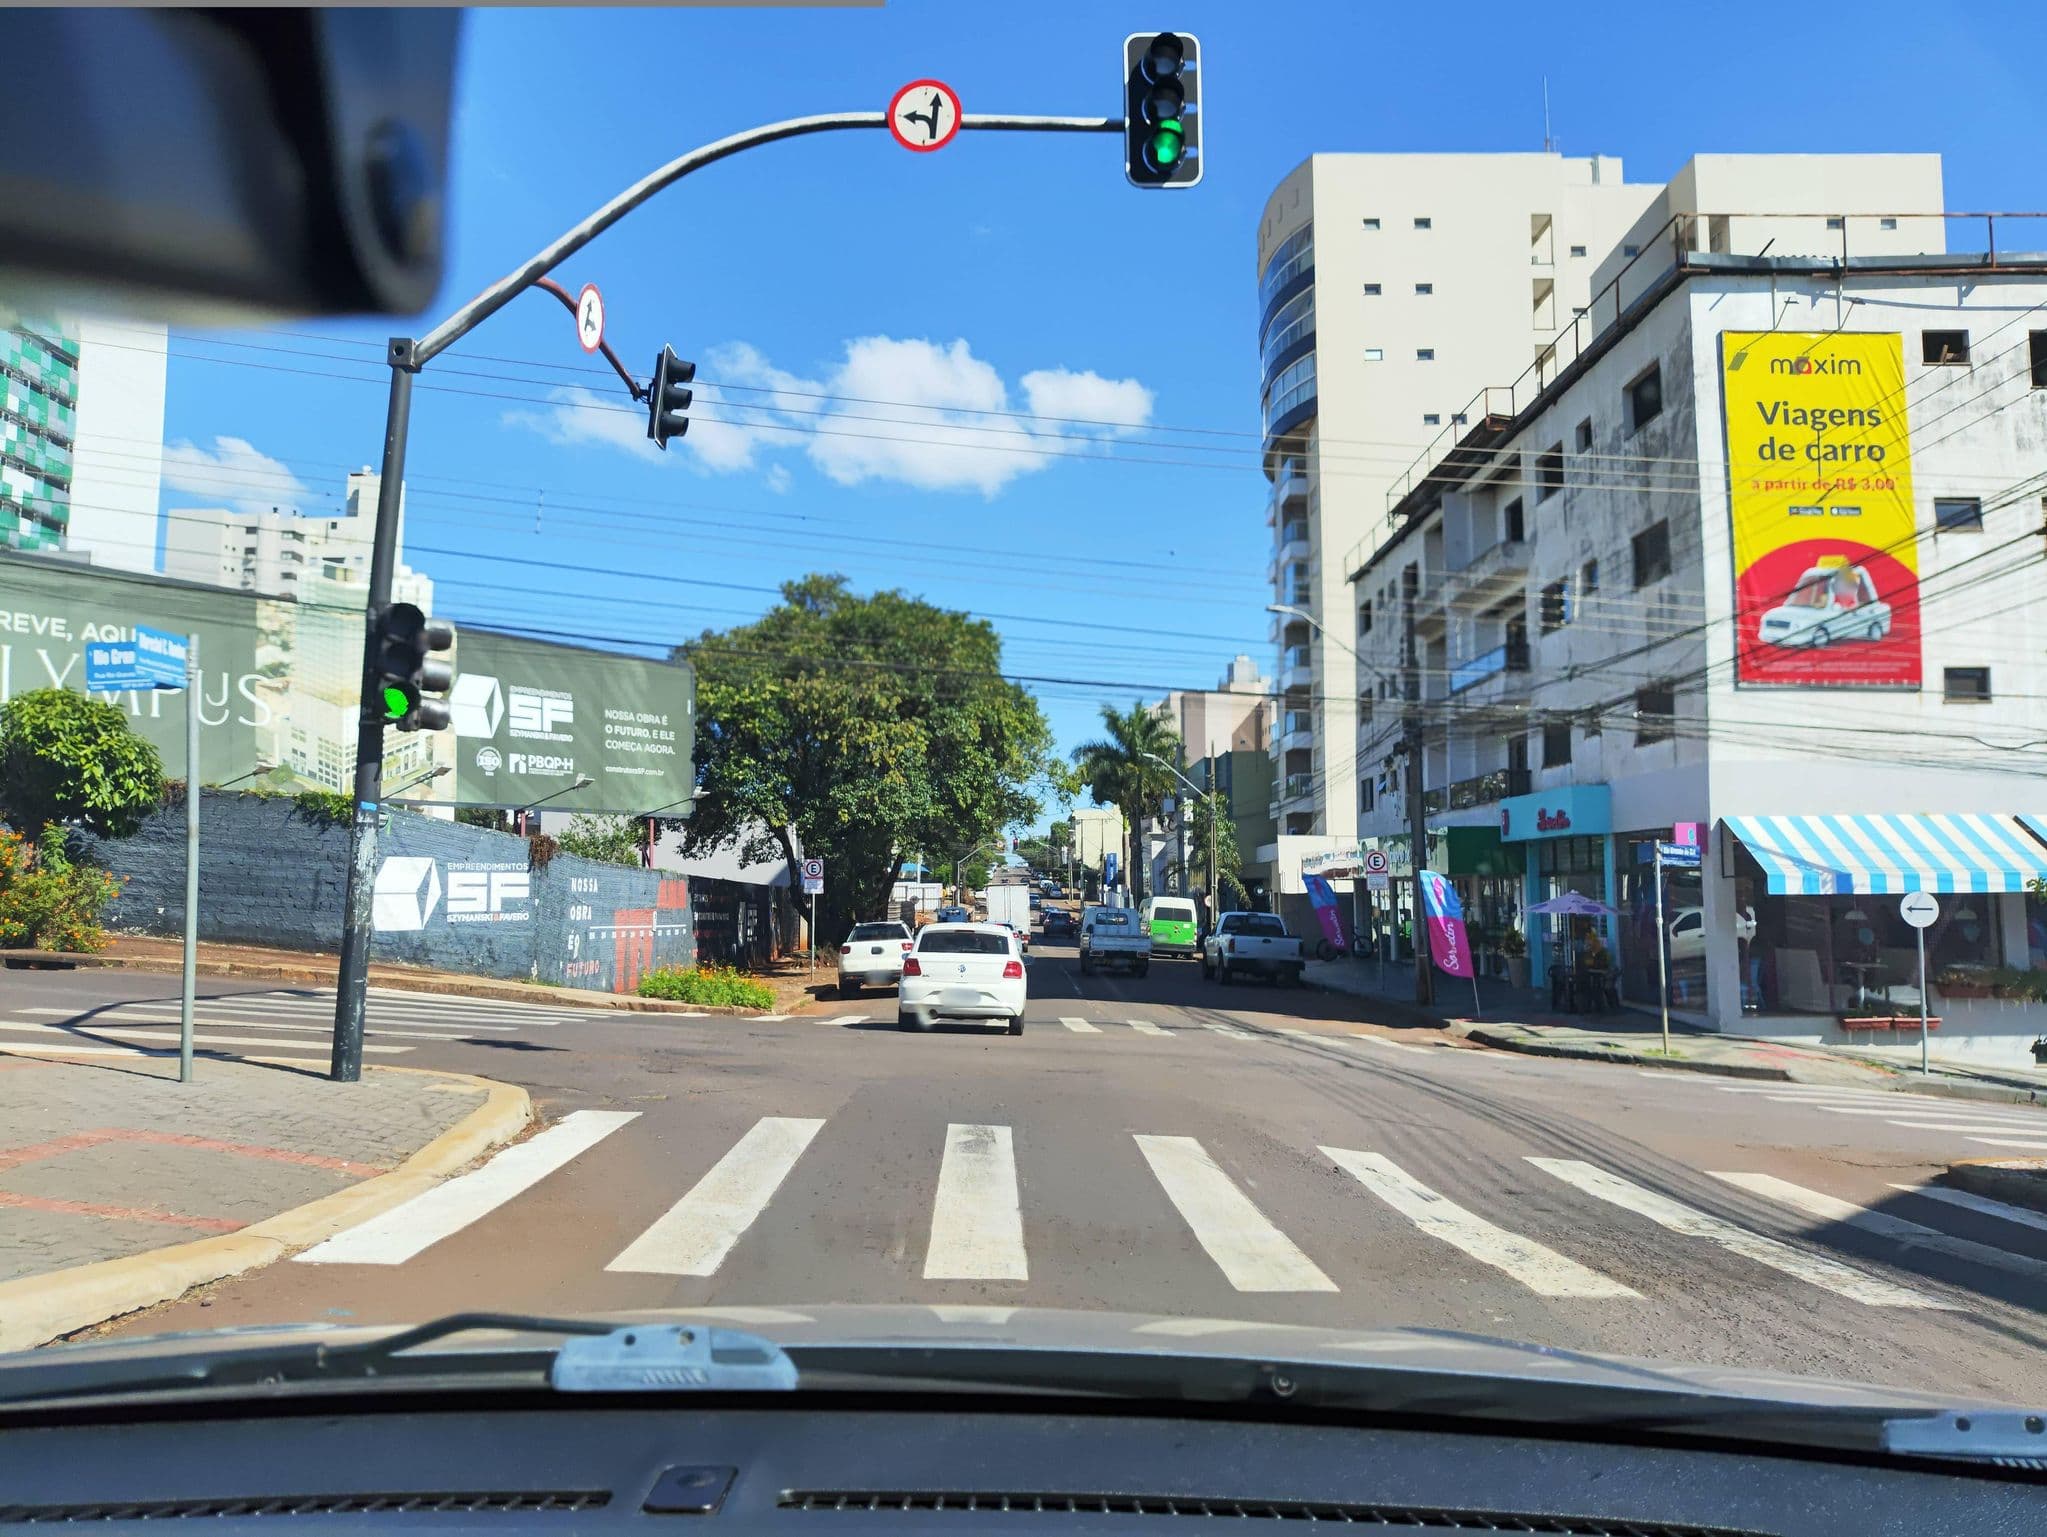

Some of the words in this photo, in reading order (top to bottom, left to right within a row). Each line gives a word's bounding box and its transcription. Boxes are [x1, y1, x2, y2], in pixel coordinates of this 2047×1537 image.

[1770, 353, 1861, 376] maxim
[1756, 400, 1881, 431] Viagens
[1758, 436, 1795, 461] de
[1805, 442, 1886, 462] carro
[1764, 478, 1806, 492] partir
[1812, 477, 1831, 491] de
[605, 708, 635, 722] NOSSA
[636, 712, 661, 725] OBRA
[605, 723, 613, 734] O
[652, 729, 658, 739] E
[660, 730, 676, 741] ELE
[605, 739, 643, 753] COMEÇA
[447, 861, 530, 872] EMPREENDIMENTOS
[810, 863, 817, 873] E
[1373, 855, 1381, 867] E
[447, 872, 530, 913] SF
[571, 877, 599, 893] NOSSA
[569, 904, 593, 921] OBRA
[566, 959, 600, 978] FUTURO
